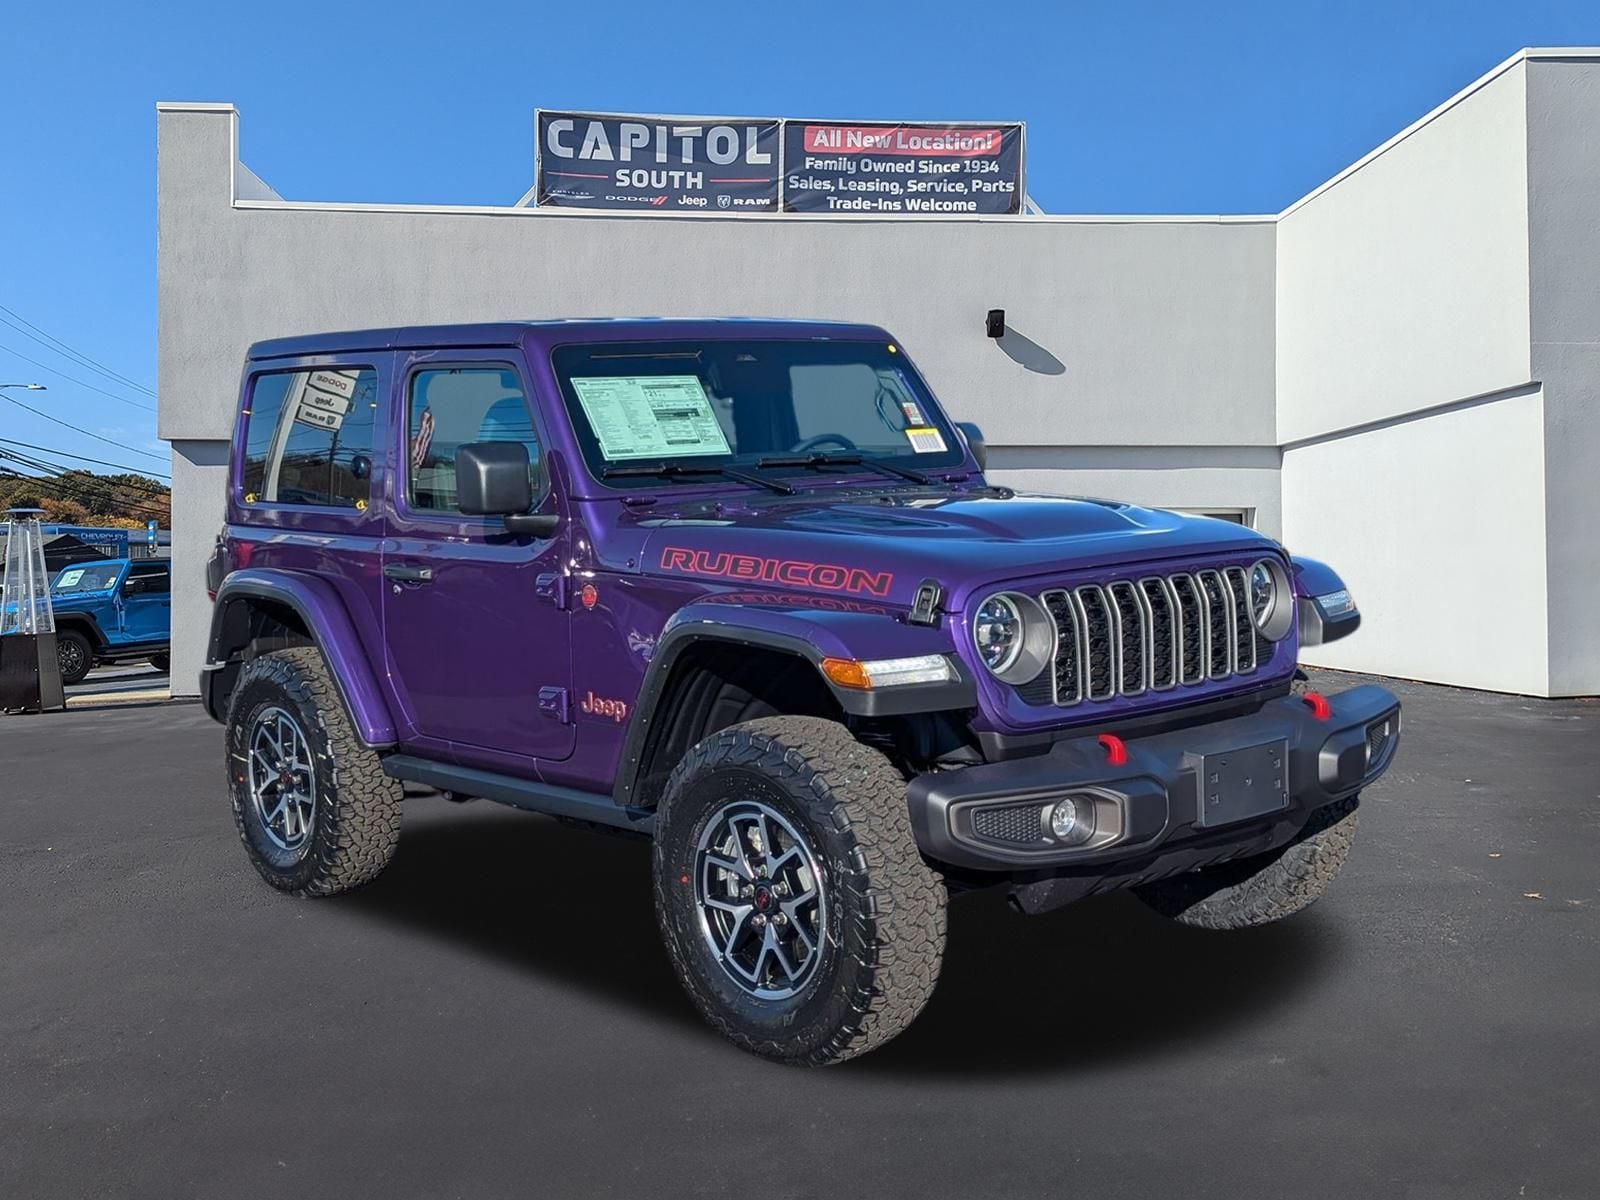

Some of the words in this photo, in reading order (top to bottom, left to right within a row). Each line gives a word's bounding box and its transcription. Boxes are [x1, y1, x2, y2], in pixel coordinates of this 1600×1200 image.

[547, 119, 771, 165] CAPITOL
[813, 130, 841, 148] All
[846, 131, 891, 149] New
[896, 133, 993, 151] Location!
[805, 157, 856, 174] Family
[860, 158, 915, 173] Owned
[918, 160, 960, 174] Since
[963, 160, 999, 173] 1934
[615, 168, 703, 189] SOUTH
[789, 175, 835, 192] Sales,
[838, 178, 904, 195] Leasing,
[907, 179, 968, 195] Service,
[972, 180, 1015, 193] Parts
[678, 194, 708, 207] Jeep
[733, 198, 770, 206] RAM
[827, 196, 902, 211] Trade-Ins
[904, 199, 977, 211] Welcome
[660, 547, 894, 597] RUBICON
[582, 691, 627, 722] Jeep
